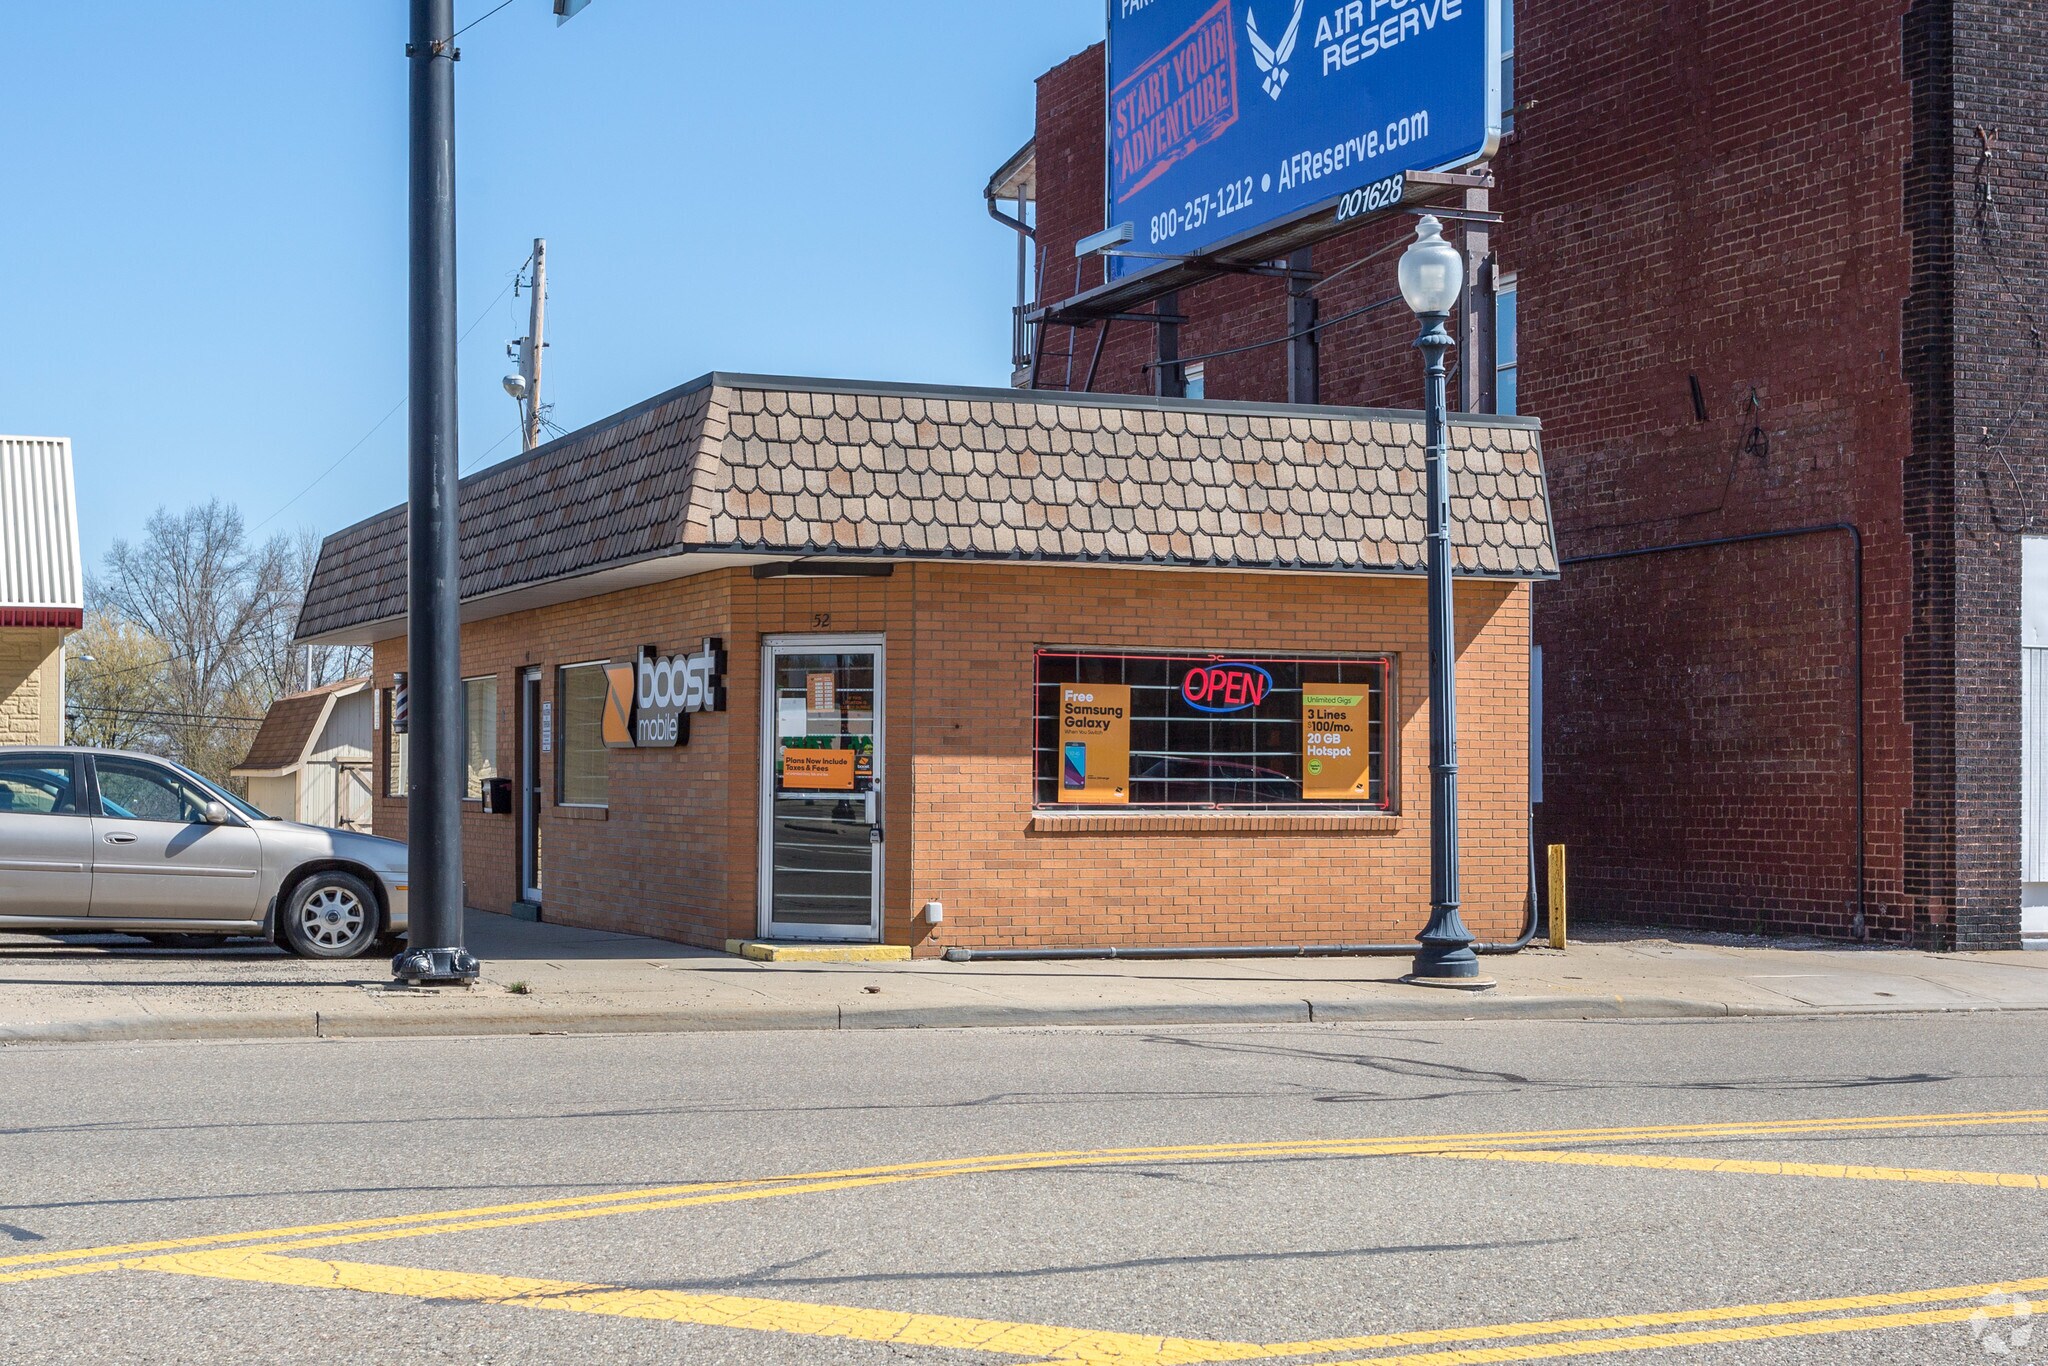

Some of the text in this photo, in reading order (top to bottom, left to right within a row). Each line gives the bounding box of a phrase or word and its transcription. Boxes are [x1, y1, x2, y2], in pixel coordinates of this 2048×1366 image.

[1314, 0, 1363, 48] AIR
[1323, 0, 1463, 77] RESERVE
[1116, 25, 1226, 140] START YOUR
[1120, 66, 1229, 183] ADVENTURE
[1150, 109, 1430, 246] 800-257-1212 AFReserve.com
[1338, 174, 1404, 222] 001628
[812, 613, 830, 628] 52
[637, 644, 715, 708] boost
[1184, 667, 1265, 706] OPEN
[1064, 689, 1094, 702] Free
[1307, 696, 1352, 705] Unlimited Gigs
[1064, 703, 1123, 719] Samsung
[1307, 709, 1347, 720] 3 Lines
[638, 713, 677, 741] mobile
[1064, 716, 1111, 731] Galaxy
[1307, 721, 1354, 732] $100/mo.
[1307, 733, 1341, 744] 20 GB
[1307, 745, 1352, 759] Hotspot
[785, 756, 805, 764] Plans
[806, 757, 822, 765] Now
